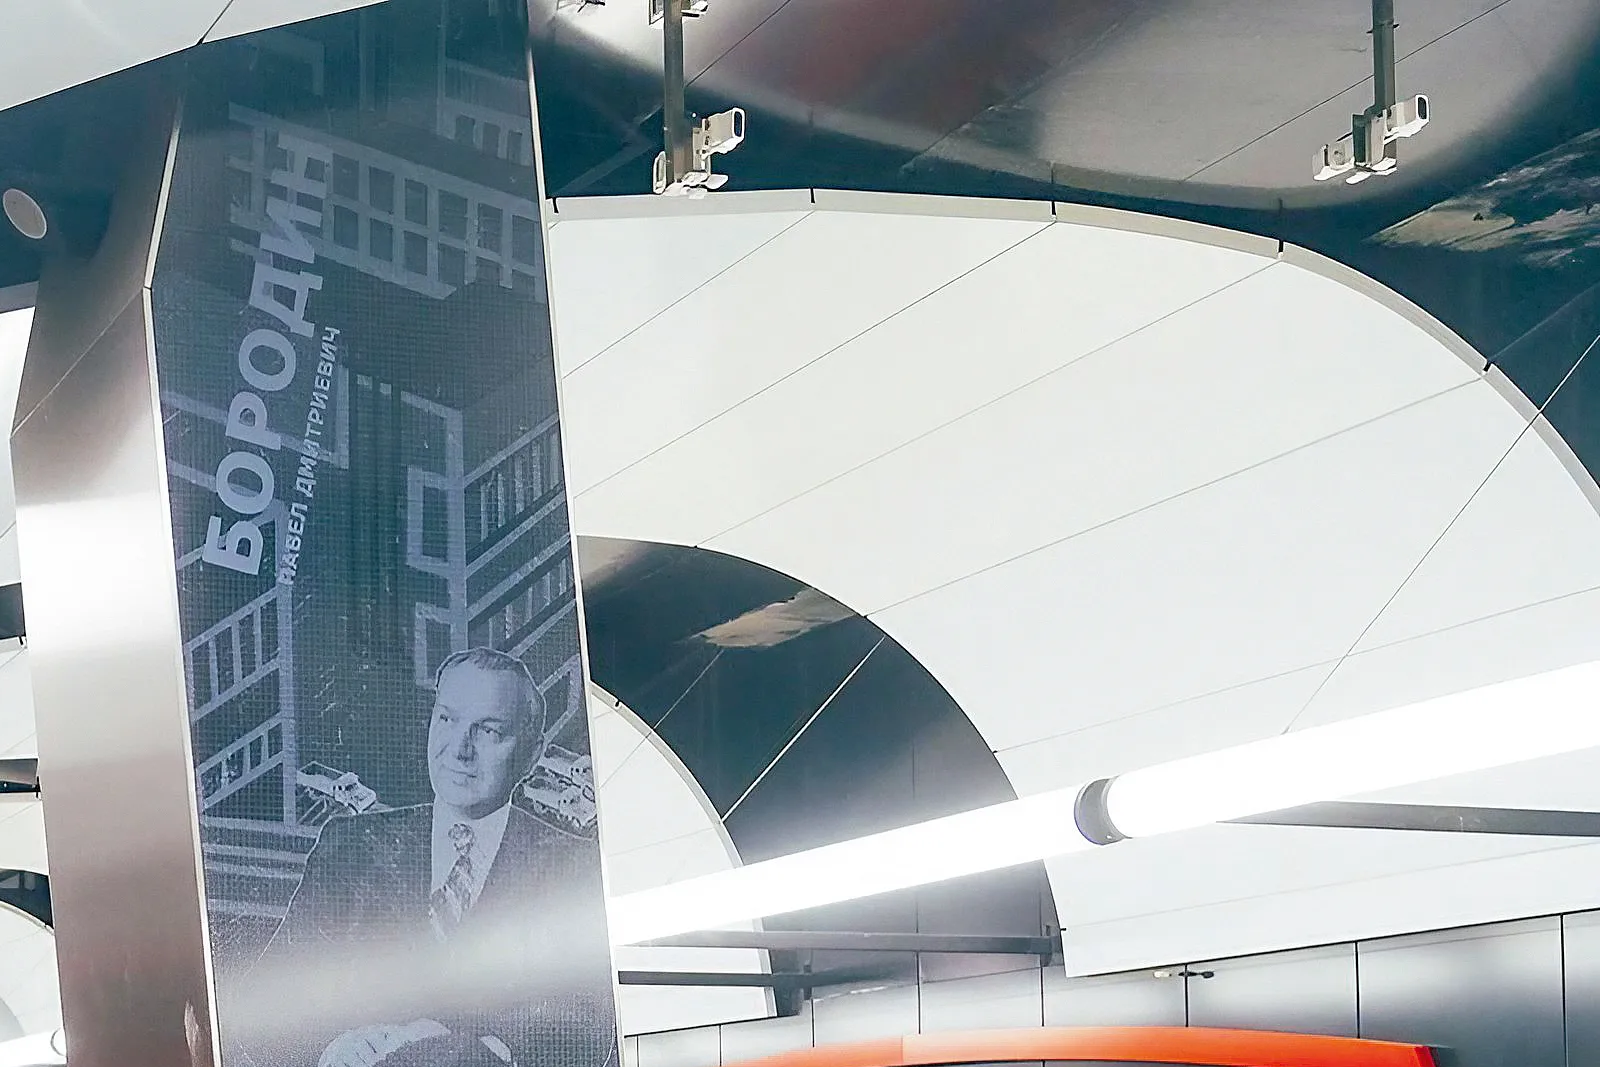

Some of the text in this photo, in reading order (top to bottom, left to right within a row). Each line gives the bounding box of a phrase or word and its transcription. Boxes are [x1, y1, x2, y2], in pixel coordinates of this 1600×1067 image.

[202, 130, 331, 576] БОРОДИН
[276, 325, 341, 586] ПАВЕЛ ДМИТРИЕВИЧ
